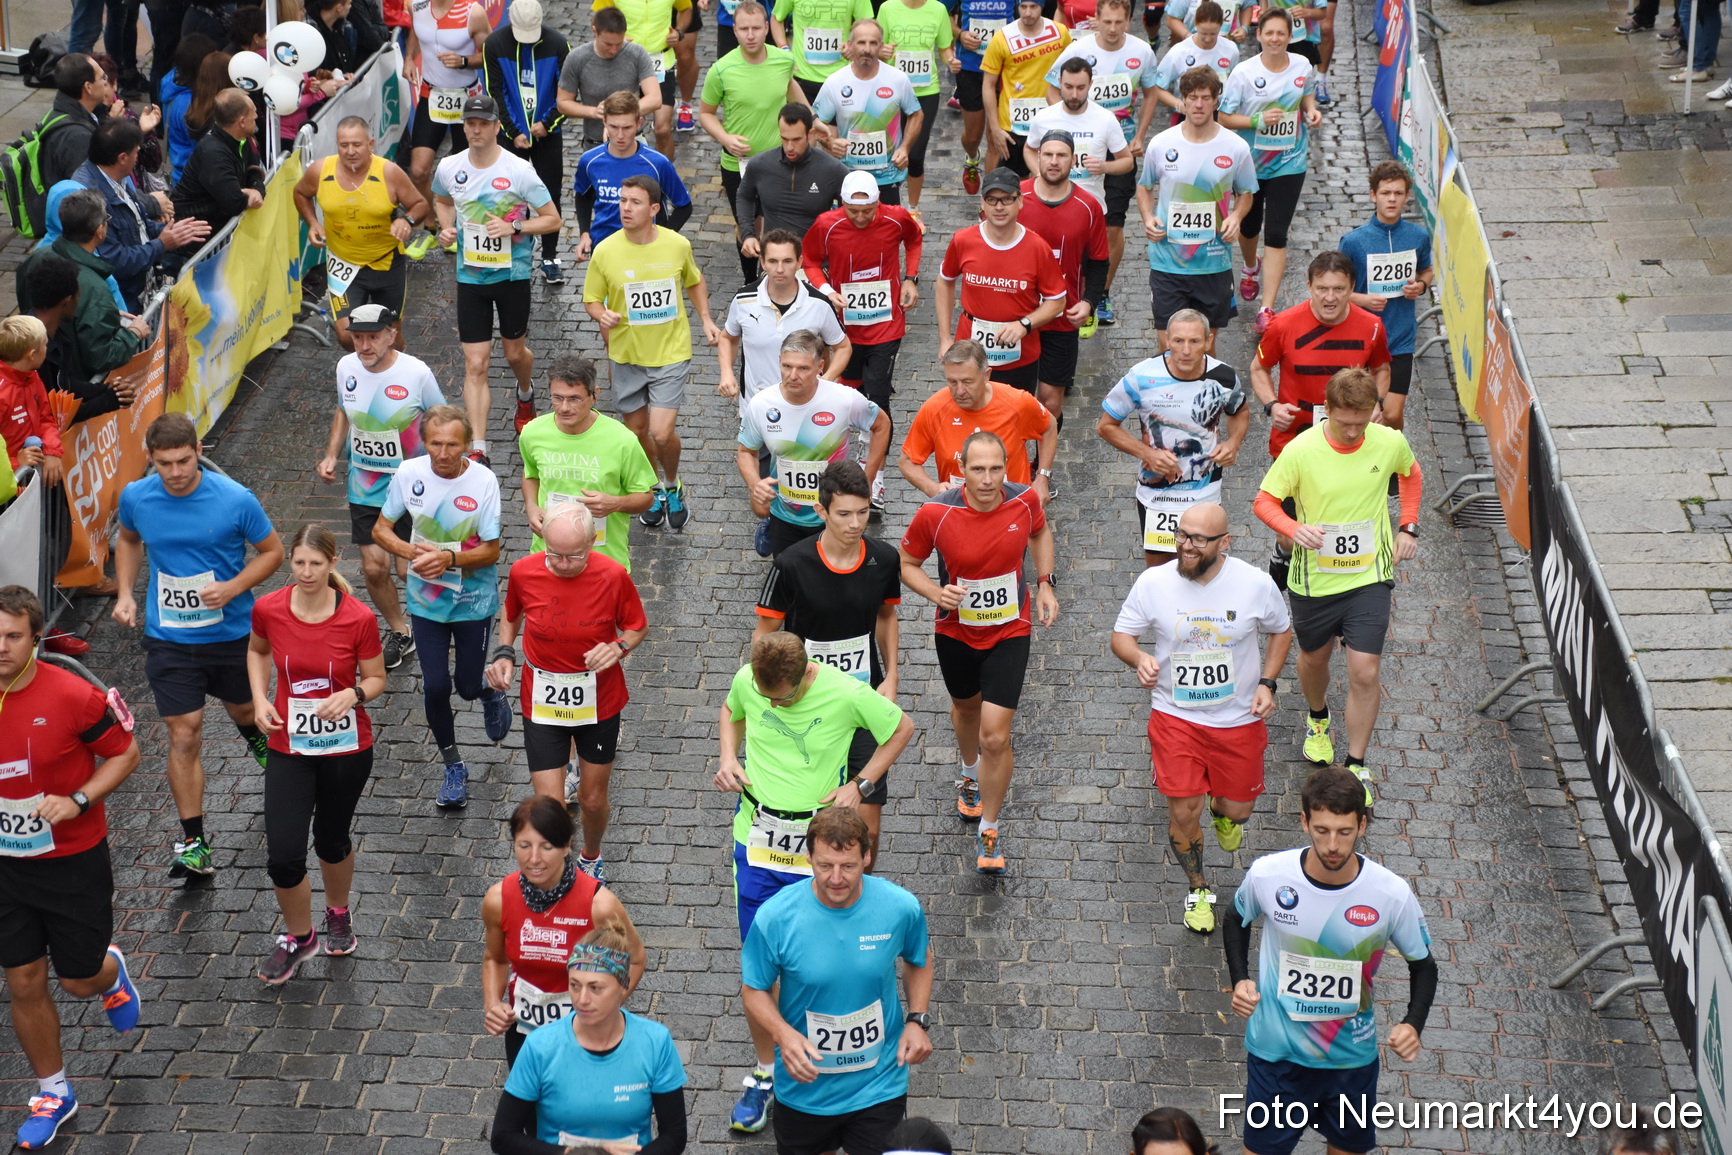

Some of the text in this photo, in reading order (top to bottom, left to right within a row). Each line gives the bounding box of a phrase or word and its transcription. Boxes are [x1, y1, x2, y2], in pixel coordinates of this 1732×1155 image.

[969, 2, 1007, 10] SYSCAD
[974, 28, 994, 41] 221
[807, 36, 839, 51] 3014
[1013, 44, 1063, 64] MAX BÖGL
[900, 60, 930, 73] 3015
[1094, 83, 1129, 100] 2439
[437, 95, 462, 110] 234
[1014, 108, 1046, 121] 281
[850, 141, 883, 156] 2280
[1173, 213, 1213, 228] 2448
[1183, 231, 1201, 240] Peter
[473, 235, 502, 252] 149
[477, 254, 498, 263] Adrian
[327, 255, 354, 282] 028
[1373, 262, 1414, 282] 2286
[966, 272, 1019, 290] NEUMARKT
[631, 289, 672, 309] 2037
[848, 292, 887, 309] 2462
[639, 312, 668, 321] Thorsten
[353, 437, 397, 458] 2530
[361, 458, 391, 468] Klemens
[543, 451, 601, 469] NOVINA
[543, 467, 599, 484] HOTELS
[786, 472, 818, 490] 169
[789, 490, 816, 501] Thomas
[1156, 512, 1178, 532] 25
[1335, 535, 1359, 554] 83
[1333, 558, 1361, 568] Florian
[164, 588, 200, 608] 256
[970, 587, 1009, 609] 298
[178, 612, 201, 622] Franz
[976, 612, 1003, 623] Stefan
[1186, 615, 1227, 623] Landkreis
[834, 637, 865, 650] BOCK
[1176, 663, 1230, 687] 2780
[303, 681, 320, 691] DEHN
[545, 685, 584, 706] 249
[1188, 690, 1220, 701] Markus
[554, 710, 574, 720] Willi
[296, 713, 352, 735] 2035
[309, 737, 340, 750] Sabine
[765, 830, 807, 853] 147
[770, 853, 795, 866] Horst
[1273, 910, 1299, 922] PARTL
[1349, 909, 1376, 921] Hervis
[1314, 960, 1355, 972] BOCK
[1286, 969, 1354, 1000] 2320
[520, 997, 573, 1026] 3097
[840, 1005, 877, 1025] BOCK
[1295, 1000, 1341, 1015] Thorsten
[816, 1018, 880, 1052] 2795
[836, 1054, 866, 1066] Claus
[614, 1095, 630, 1103] Julia
